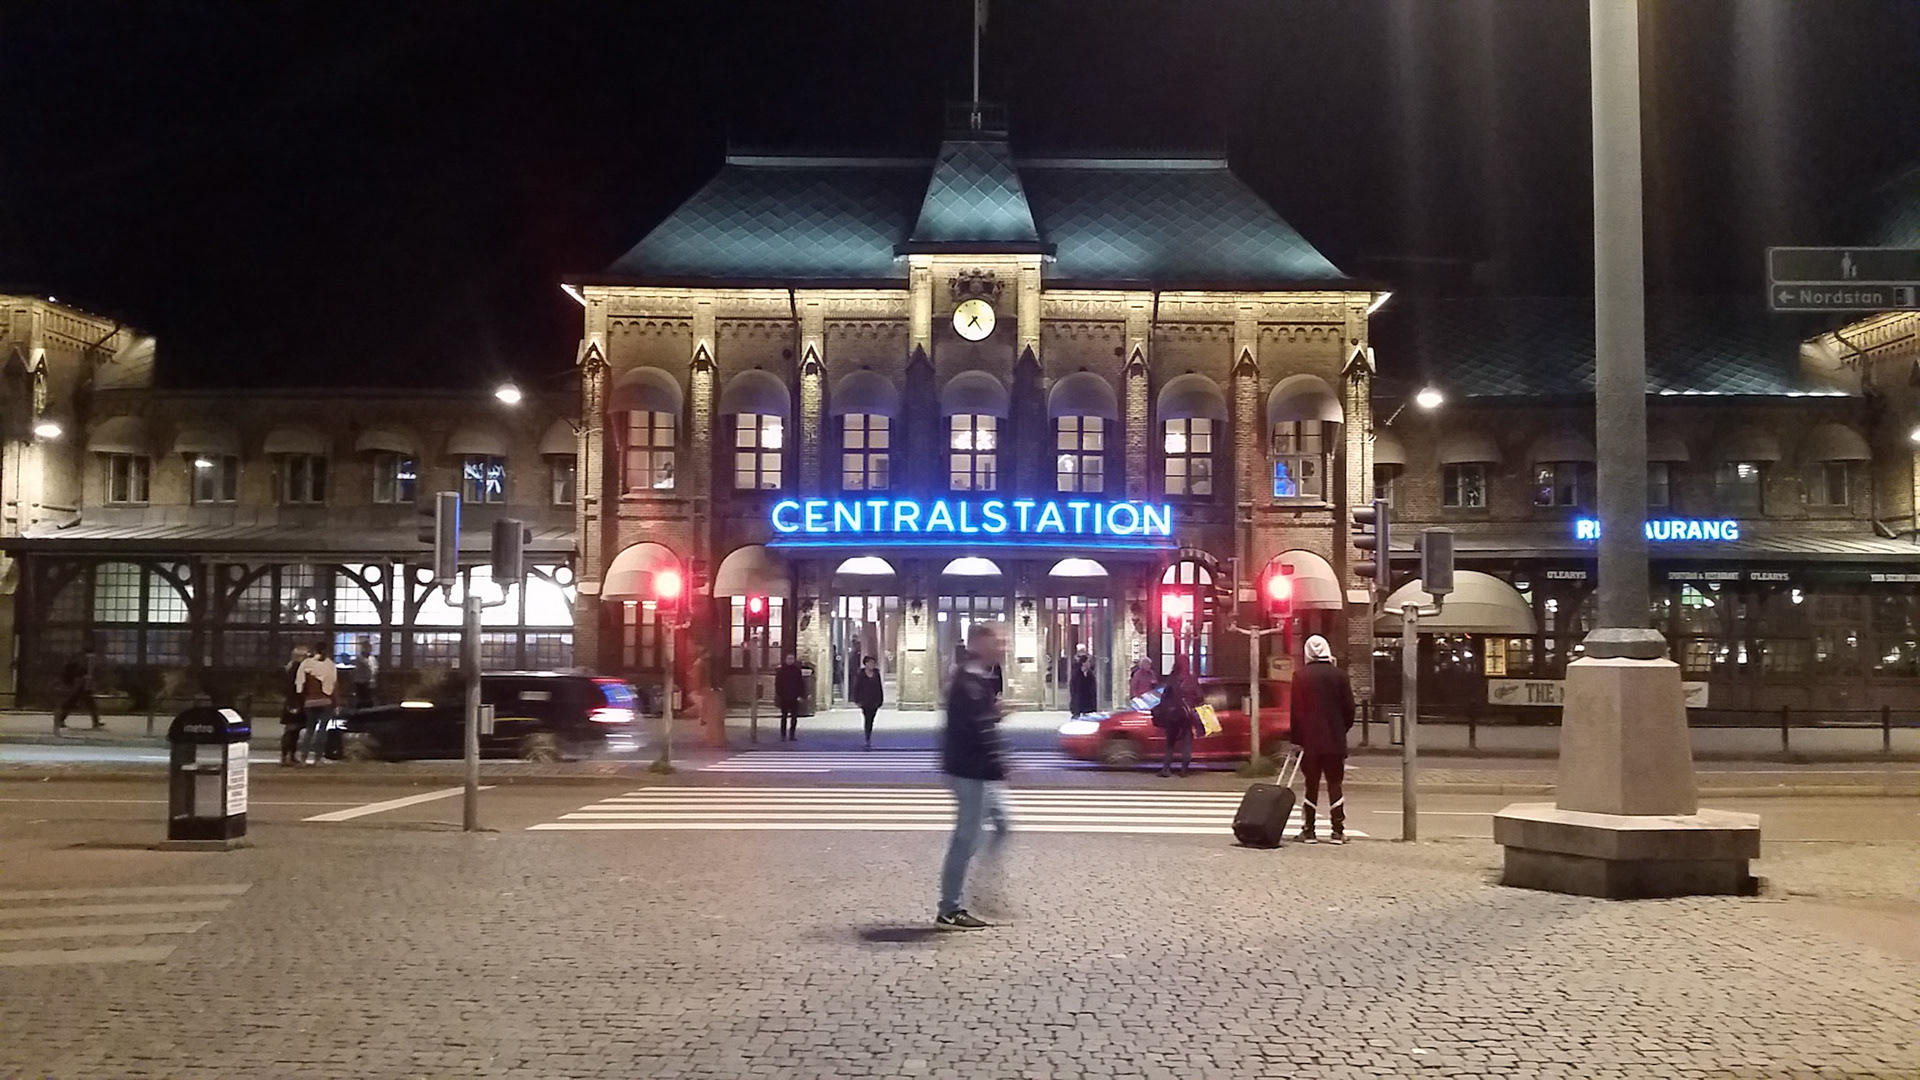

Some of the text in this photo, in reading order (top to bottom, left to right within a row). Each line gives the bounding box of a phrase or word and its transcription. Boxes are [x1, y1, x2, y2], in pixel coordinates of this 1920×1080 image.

[1799, 290, 1882, 304] Nordstan
[771, 499, 1172, 536] CENTRALSTATION
[1577, 520, 1739, 540] RAURANG
[1525, 683, 1555, 703] THE
[183, 724, 214, 733] metro
